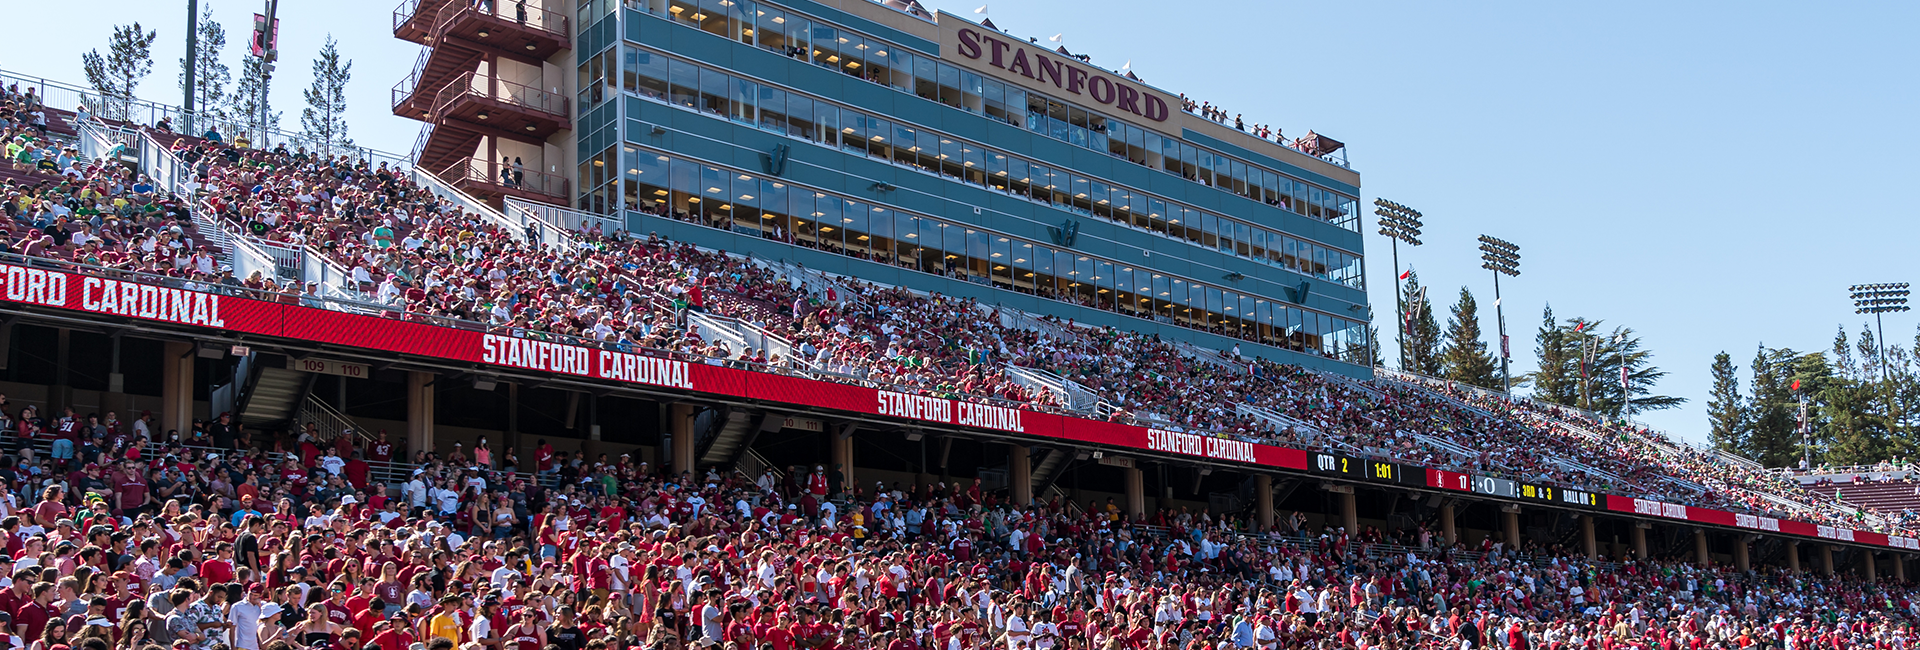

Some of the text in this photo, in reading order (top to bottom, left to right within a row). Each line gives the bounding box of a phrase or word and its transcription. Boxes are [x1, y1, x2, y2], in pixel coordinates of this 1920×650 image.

[958, 28, 1169, 122] STANFORD
[280, 269, 297, 278] 210
[82, 277, 224, 327] CARDINAL
[302, 358, 361, 378] 109 110
[483, 334, 693, 388] STANFORD CARDINAL
[878, 390, 1024, 432] STANFORD CARDINAL
[60, 421, 75, 432] 91
[806, 420, 817, 430] 111
[376, 445, 388, 456] 43
[1147, 428, 1256, 463] STANFORD CARDINAL
[1317, 454, 1348, 473] QTR 2
[1374, 462, 1391, 479] 1:01
[1458, 475, 1467, 490] 17
[1508, 482, 1513, 495] 7
[1522, 484, 1535, 497] 3RD
[1546, 488, 1552, 500] 3
[1563, 489, 1596, 506] BALL ON 3
[568, 536, 578, 550] 7
